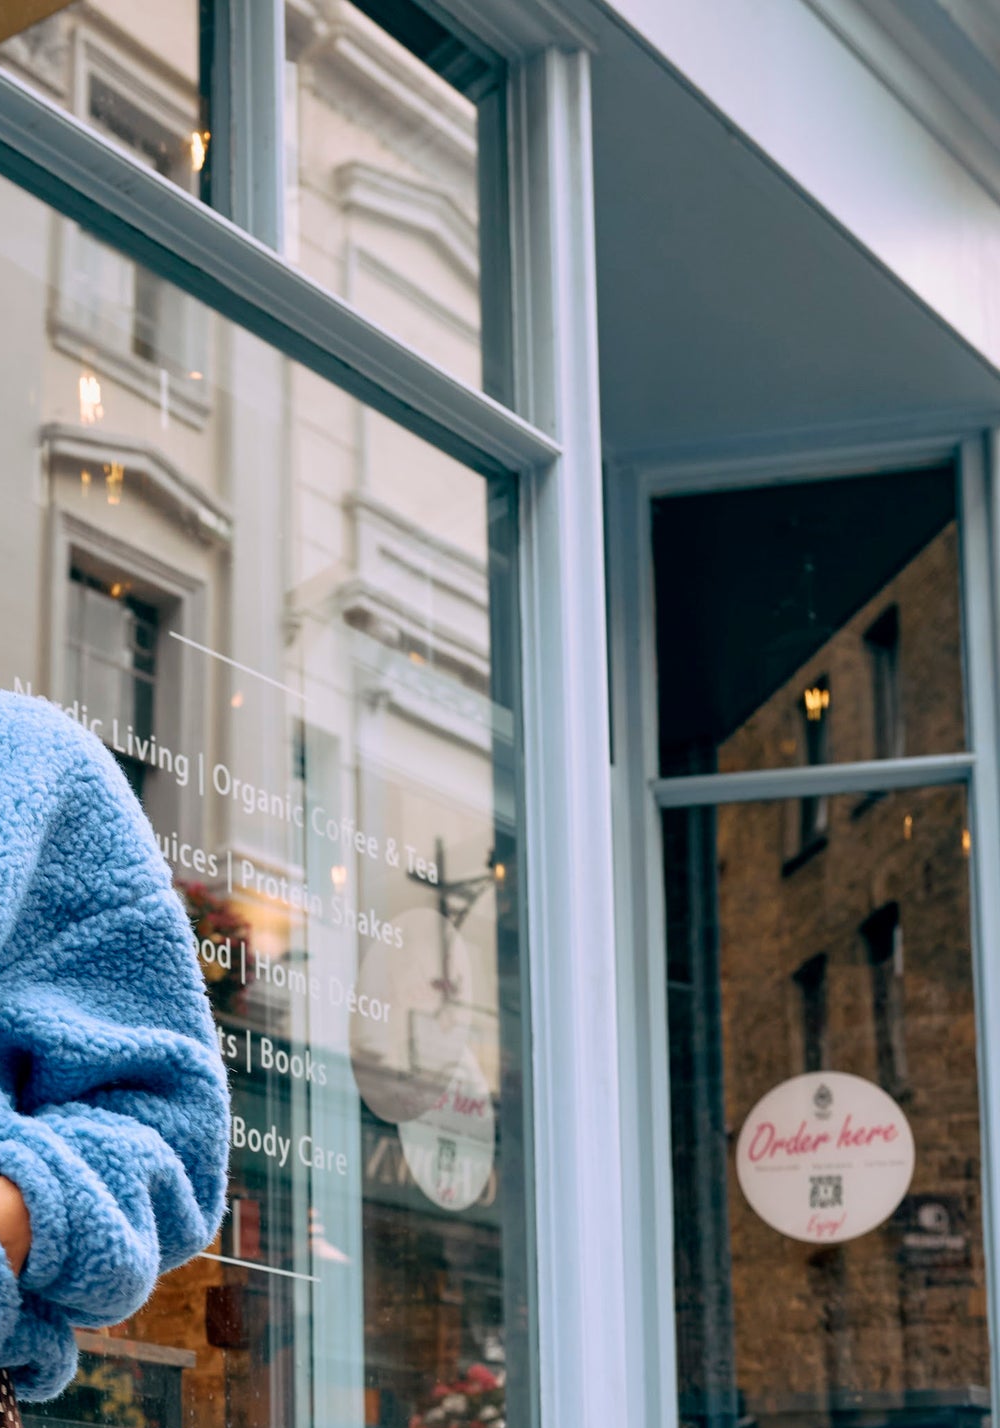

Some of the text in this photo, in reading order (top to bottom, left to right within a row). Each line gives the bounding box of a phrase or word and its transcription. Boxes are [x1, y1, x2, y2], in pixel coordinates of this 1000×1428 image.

[112, 718, 189, 787] Living
[212, 763, 304, 828] Organic
[311, 807, 378, 859] Coffee
[385, 836, 399, 869] &
[404, 844, 438, 885] Tea
[156, 831, 219, 878] uices
[241, 860, 323, 920] Protein
[333, 896, 404, 949] Shakes
[255, 950, 320, 1001] Home
[260, 1036, 328, 1087] Books
[232, 1115, 291, 1168] Body
[298, 1134, 349, 1176] Care
[748, 1114, 898, 1163] Order here
